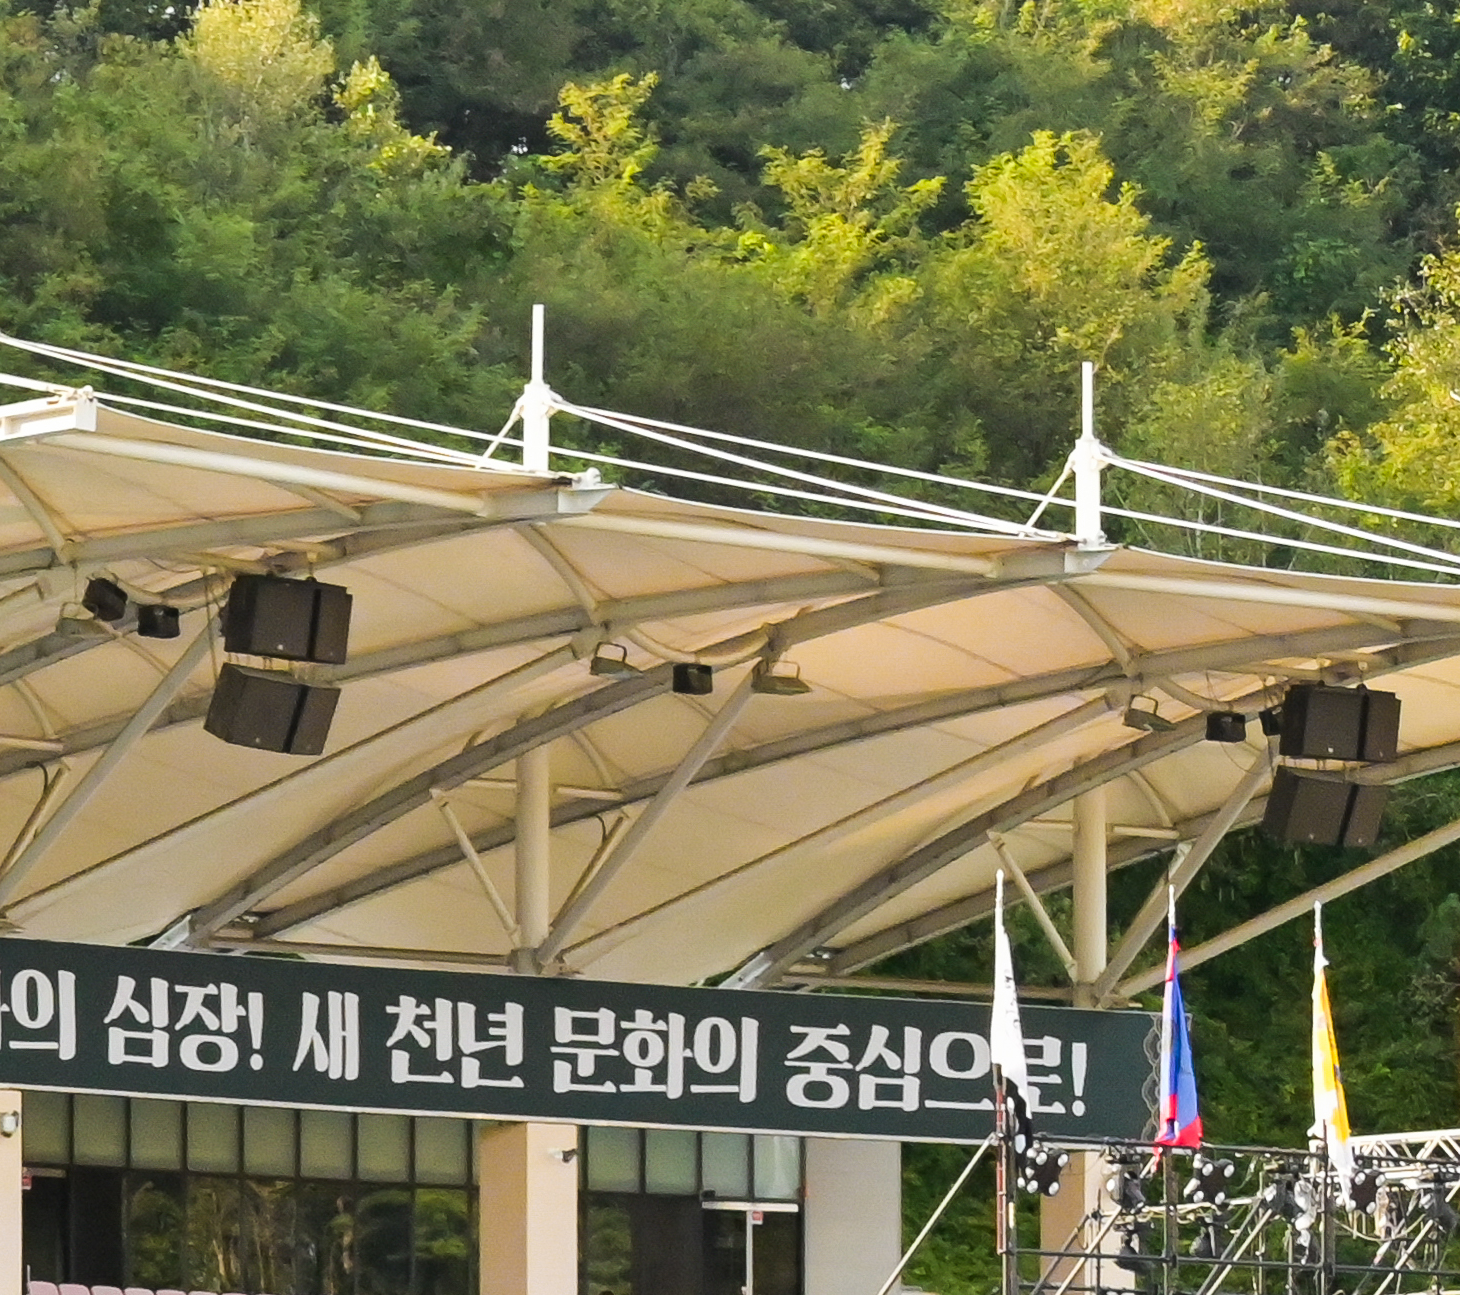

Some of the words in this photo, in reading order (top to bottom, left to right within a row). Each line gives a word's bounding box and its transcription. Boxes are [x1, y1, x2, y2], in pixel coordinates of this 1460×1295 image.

[103, 975, 264, 1072] 심장!
[292, 990, 360, 1081] 새
[385, 994, 525, 1089] 천년
[549, 1006, 760, 1104] 문화의
[783, 1023, 1088, 1117] 중심으로!
